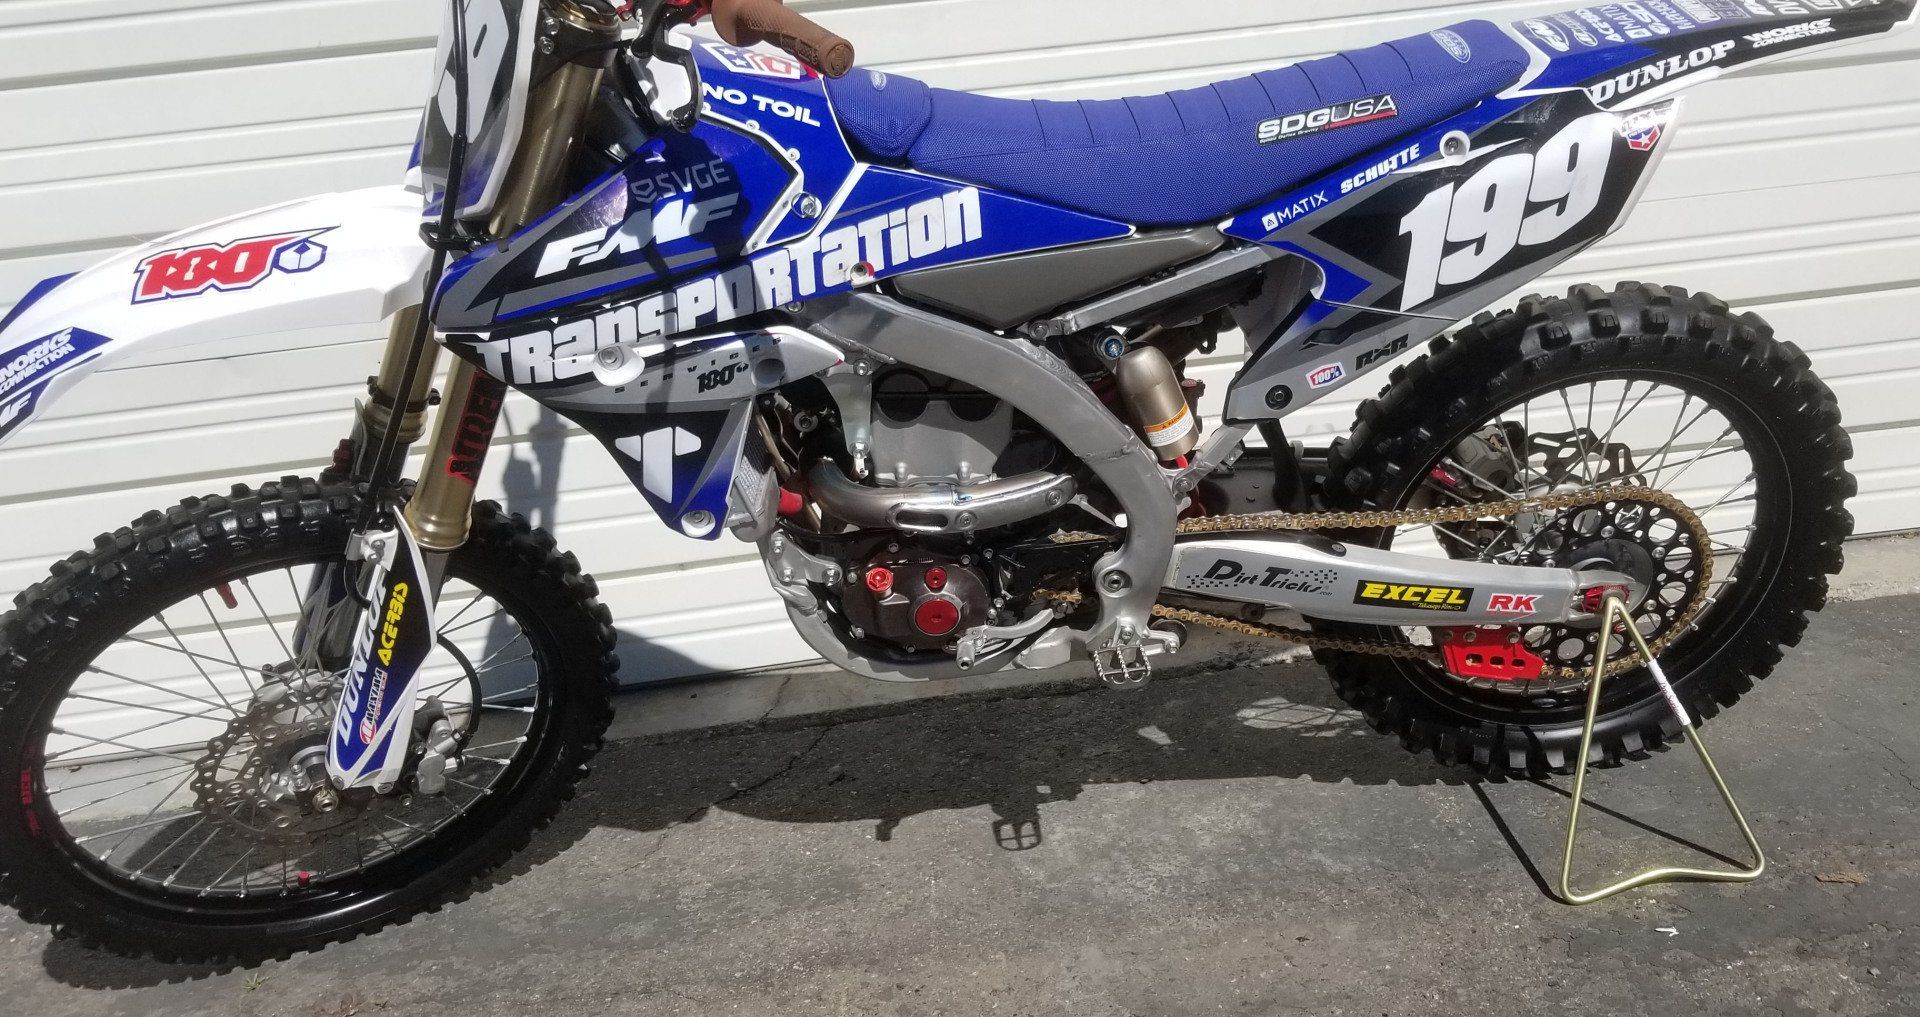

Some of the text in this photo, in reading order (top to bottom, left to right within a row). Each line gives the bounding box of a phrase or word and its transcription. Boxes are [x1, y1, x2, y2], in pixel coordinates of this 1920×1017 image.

[1601, 5, 1641, 29] MATIX
[1742, 18, 1832, 41] WORKS
[1752, 27, 1836, 48] CONNECTION
[1589, 40, 1735, 105] DUNLOP
[703, 82, 820, 127] NO TOIL
[1340, 143, 1420, 194] SCHUTTE
[1276, 191, 1329, 224] MATIX
[1399, 112, 1615, 312] 199
[535, 192, 739, 278] FMF
[1312, 365, 1342, 385] 100%
[1203, 559, 1258, 584] Dirt
[1259, 566, 1322, 593] Tricks
[1361, 583, 1465, 604] EXCEL
[1486, 593, 1542, 613] RK
[378, 582, 408, 667] ACERBIS
